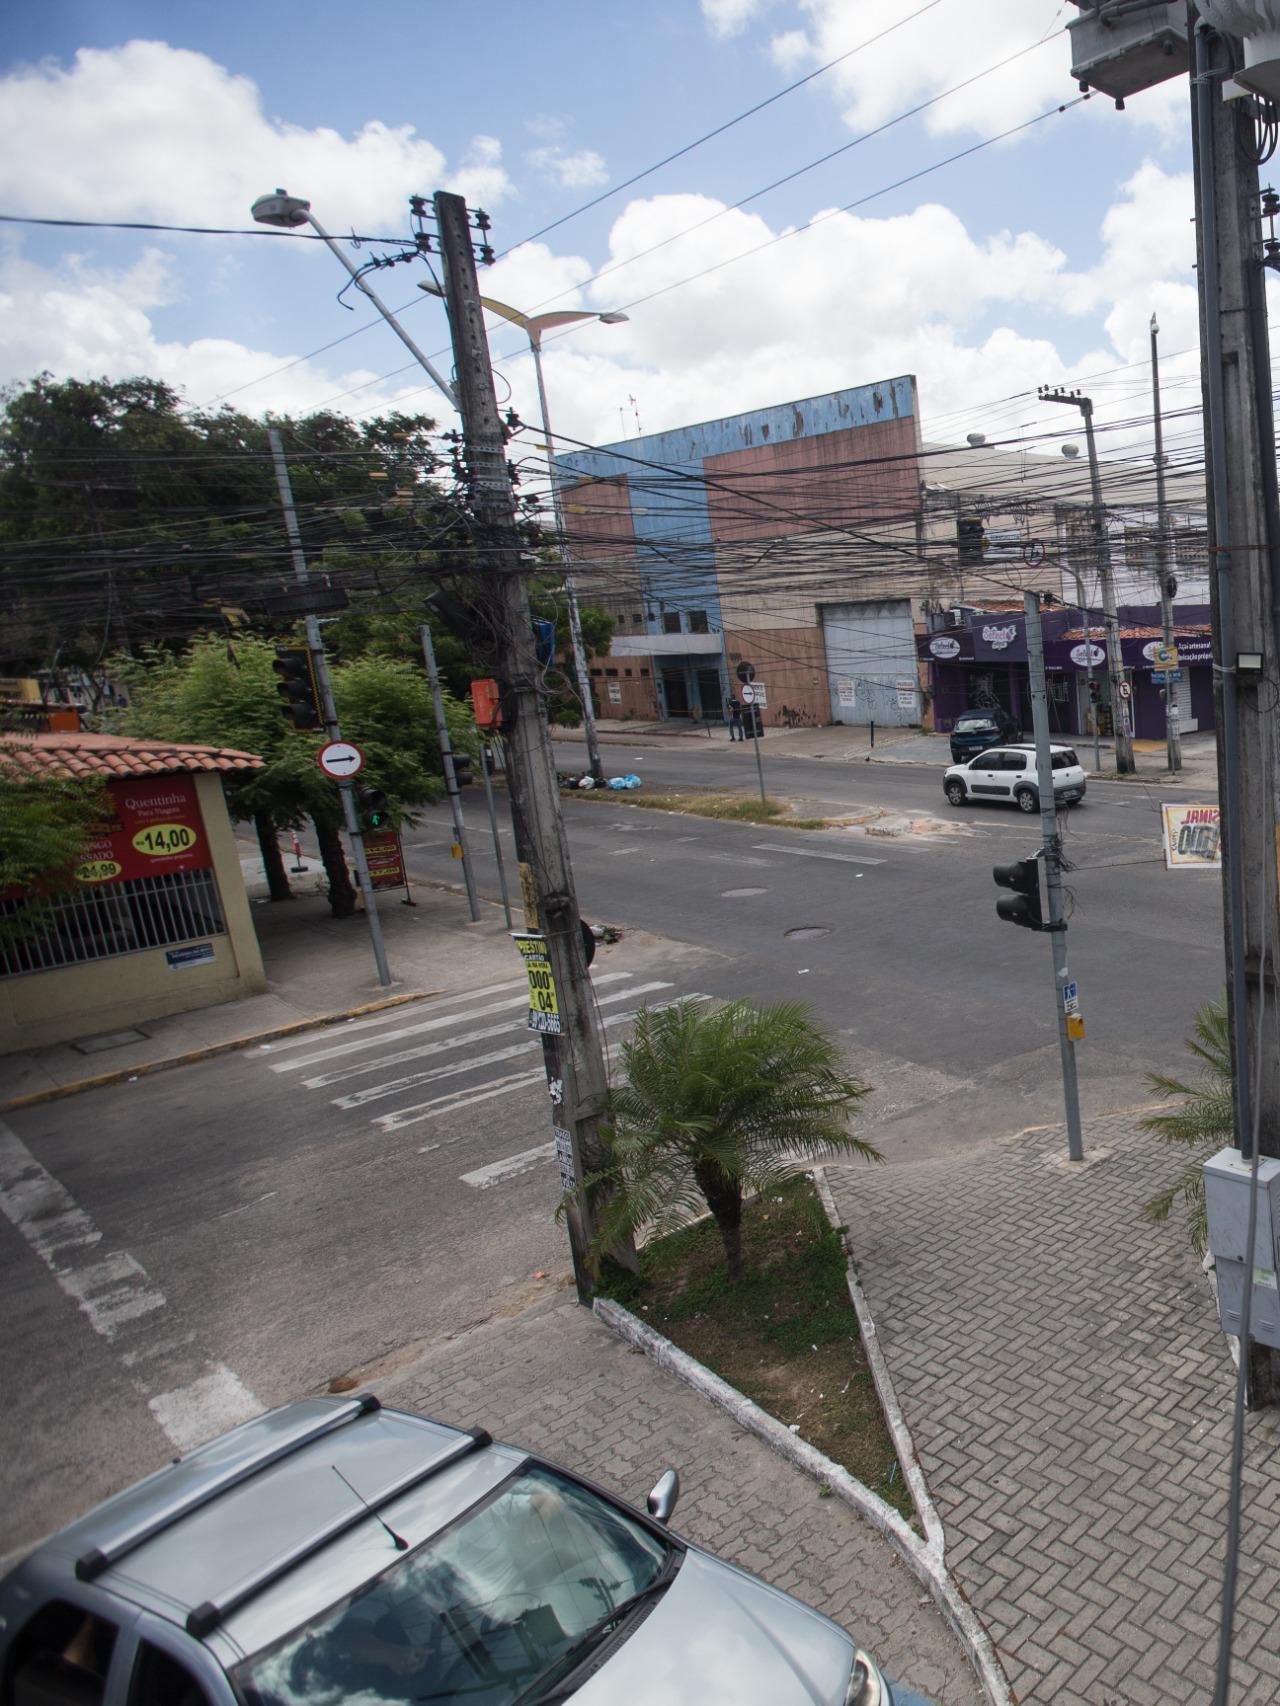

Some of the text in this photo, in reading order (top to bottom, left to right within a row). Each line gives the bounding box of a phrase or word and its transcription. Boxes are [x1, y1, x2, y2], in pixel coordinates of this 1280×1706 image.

[1189, 641, 1211, 650] artesanal
[125, 793, 186, 810] Quentinha
[145, 828, 191, 852] 14,00
